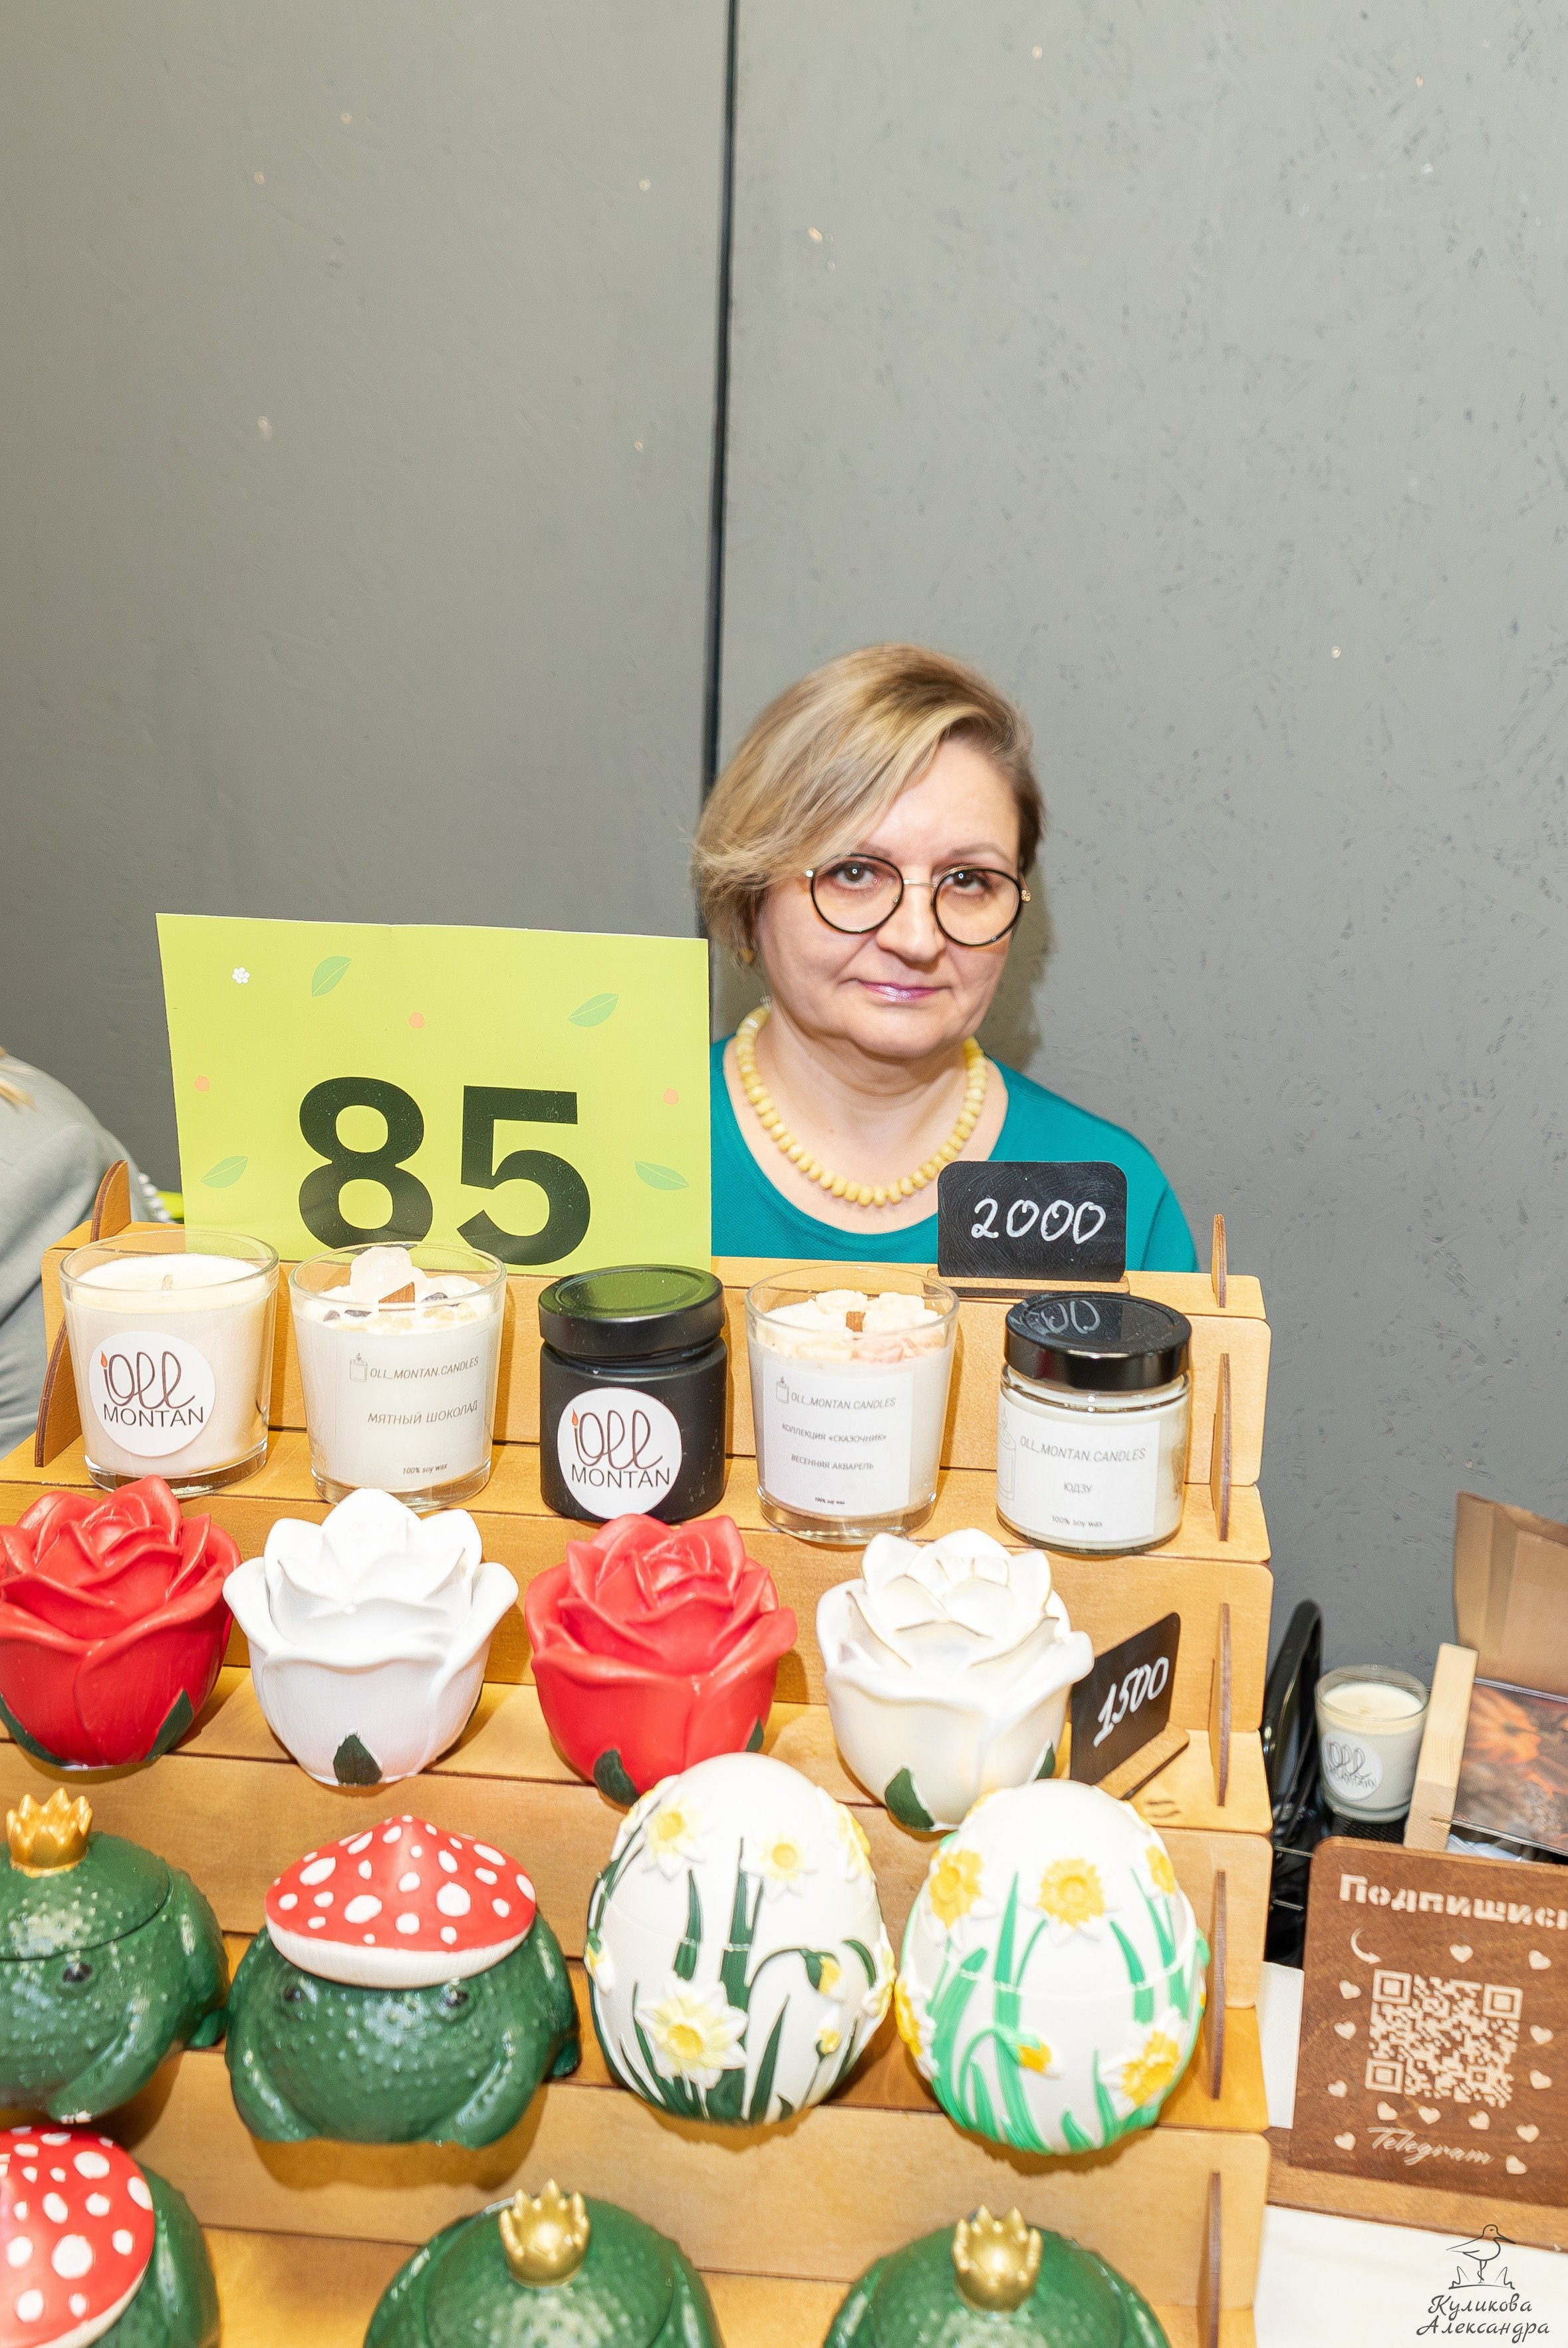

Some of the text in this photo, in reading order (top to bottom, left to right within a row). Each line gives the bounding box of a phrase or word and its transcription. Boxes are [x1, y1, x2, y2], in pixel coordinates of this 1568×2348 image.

[299, 1076, 592, 1266] 85
[971, 1198, 1107, 1244] 2000
[103, 1402, 203, 1428] MONTAN
[367, 1400, 479, 1424] МЯТНЫЙ ШОКОЛАД
[781, 1422, 826, 1440] КОЛЛЕКЦИЯ
[571, 1464, 670, 1489] MONTAN
[1093, 1656, 1169, 1748] 1500
[1367, 2127, 1495, 2166] Telegram
